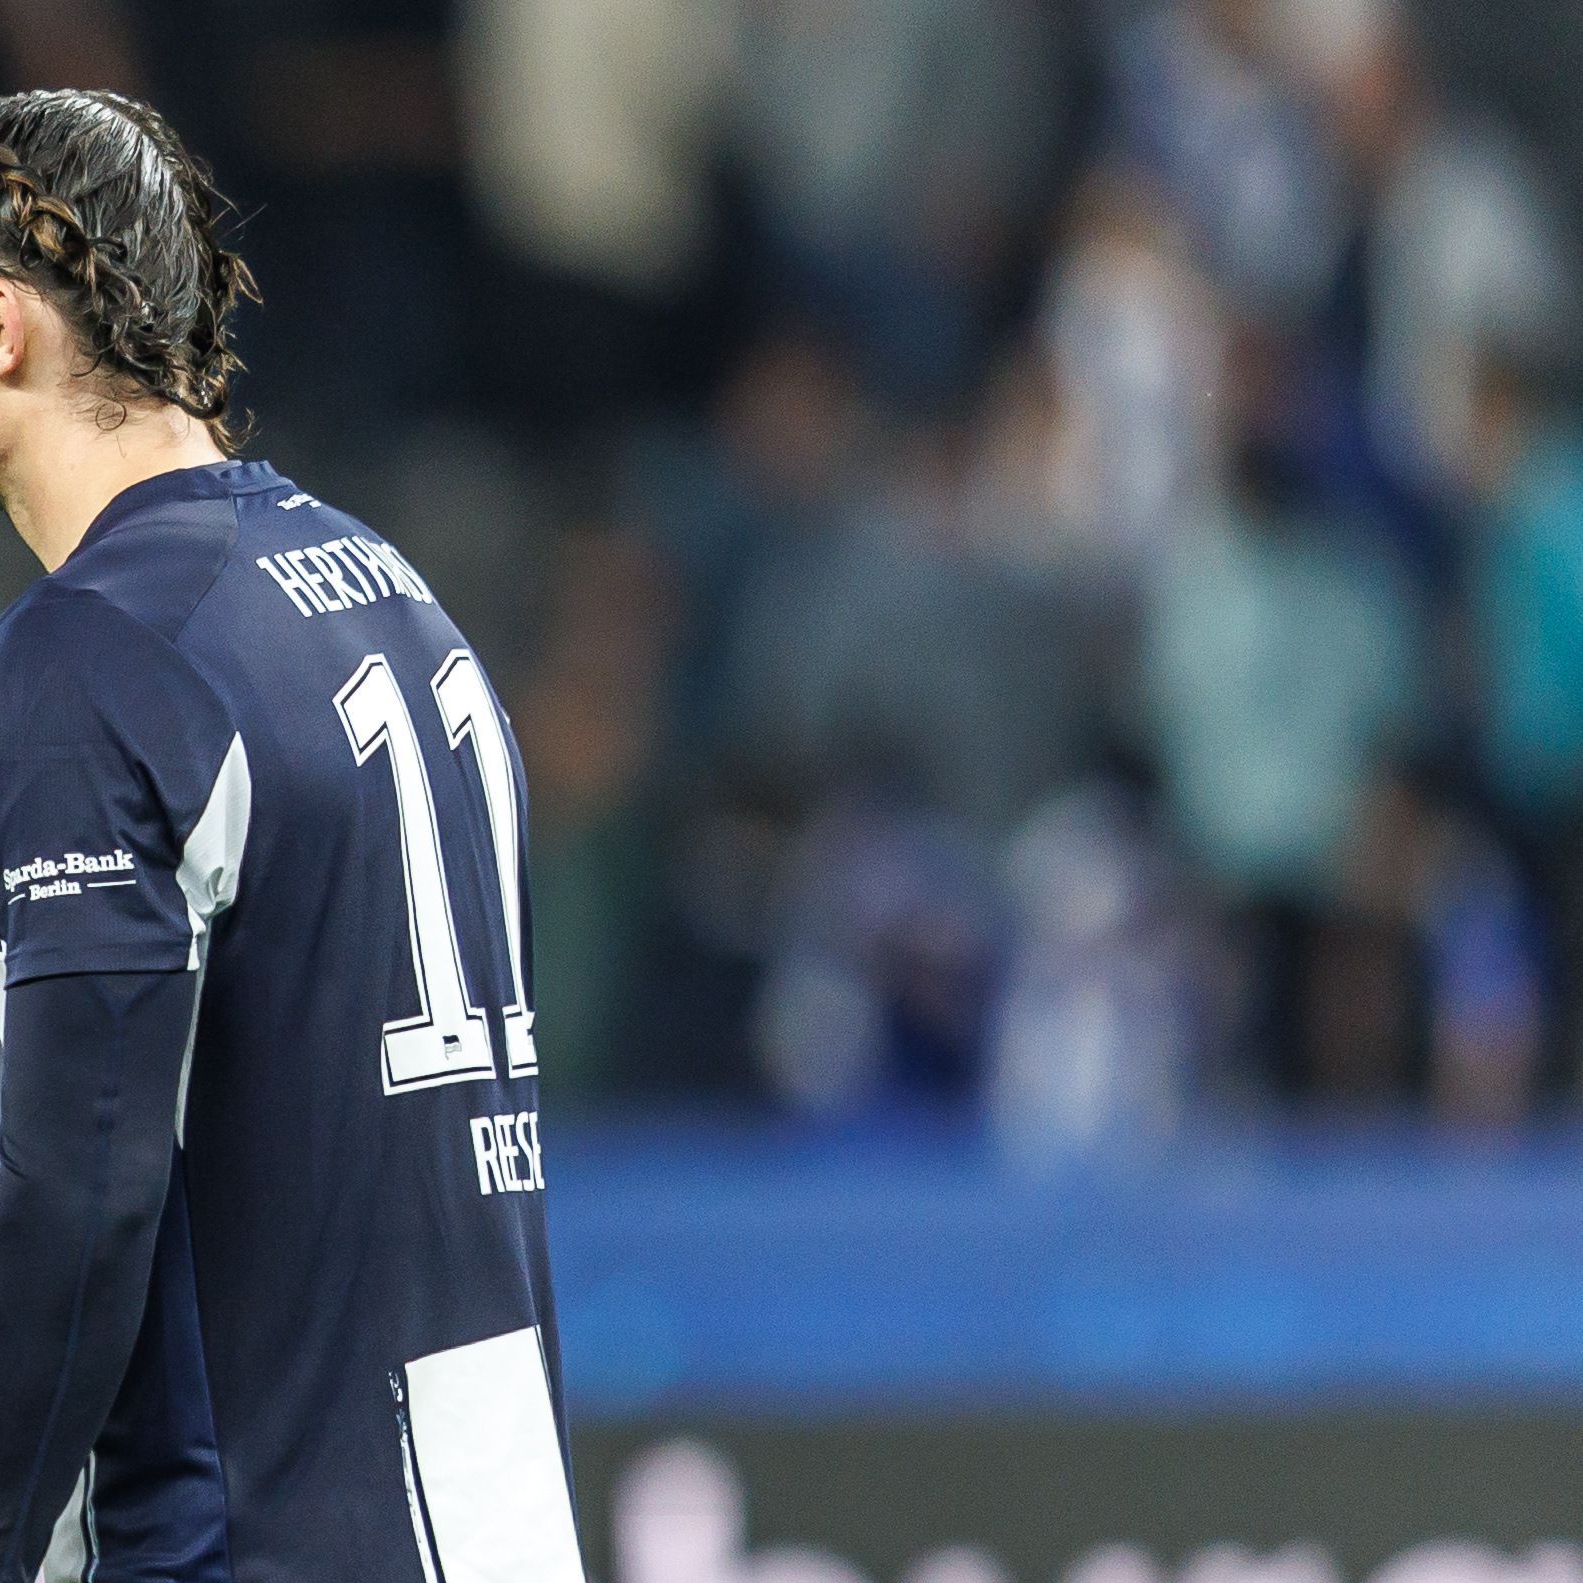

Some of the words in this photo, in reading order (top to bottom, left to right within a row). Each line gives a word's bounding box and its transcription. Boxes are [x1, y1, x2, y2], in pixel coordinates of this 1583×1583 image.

[3, 849, 135, 892] Sparda-Bank
[29, 879, 82, 900] Berlin
[332, 648, 539, 1097] 11
